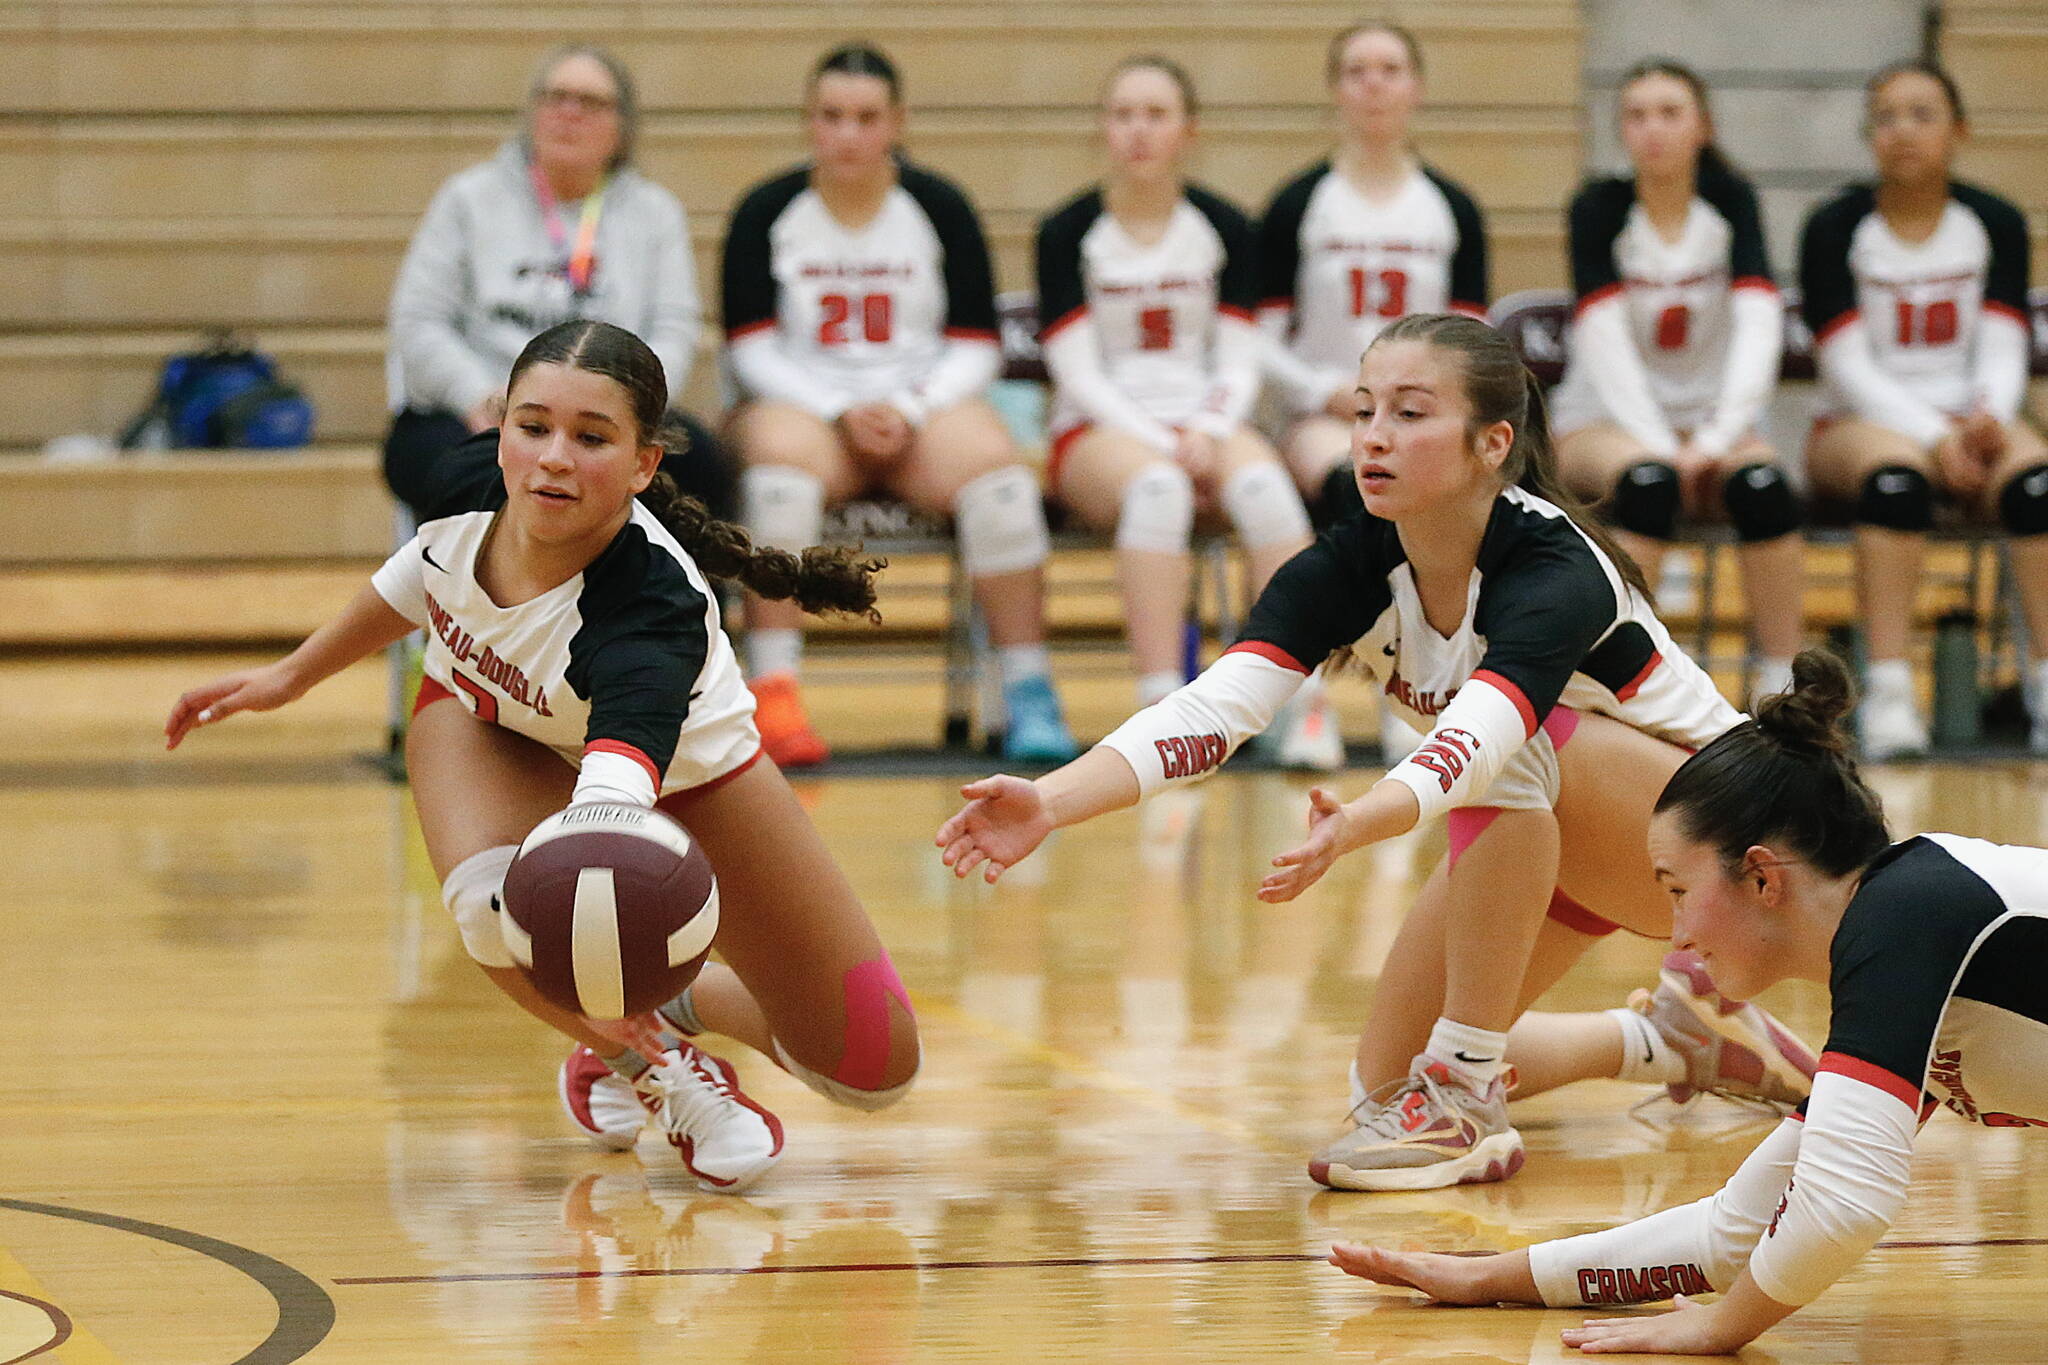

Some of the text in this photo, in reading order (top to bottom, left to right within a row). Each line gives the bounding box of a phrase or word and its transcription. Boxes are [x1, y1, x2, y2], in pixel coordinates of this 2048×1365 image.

[1351, 268, 1406, 317] 13
[819, 294, 891, 343] 20
[1577, 1263, 1715, 1305] CRIMSON
